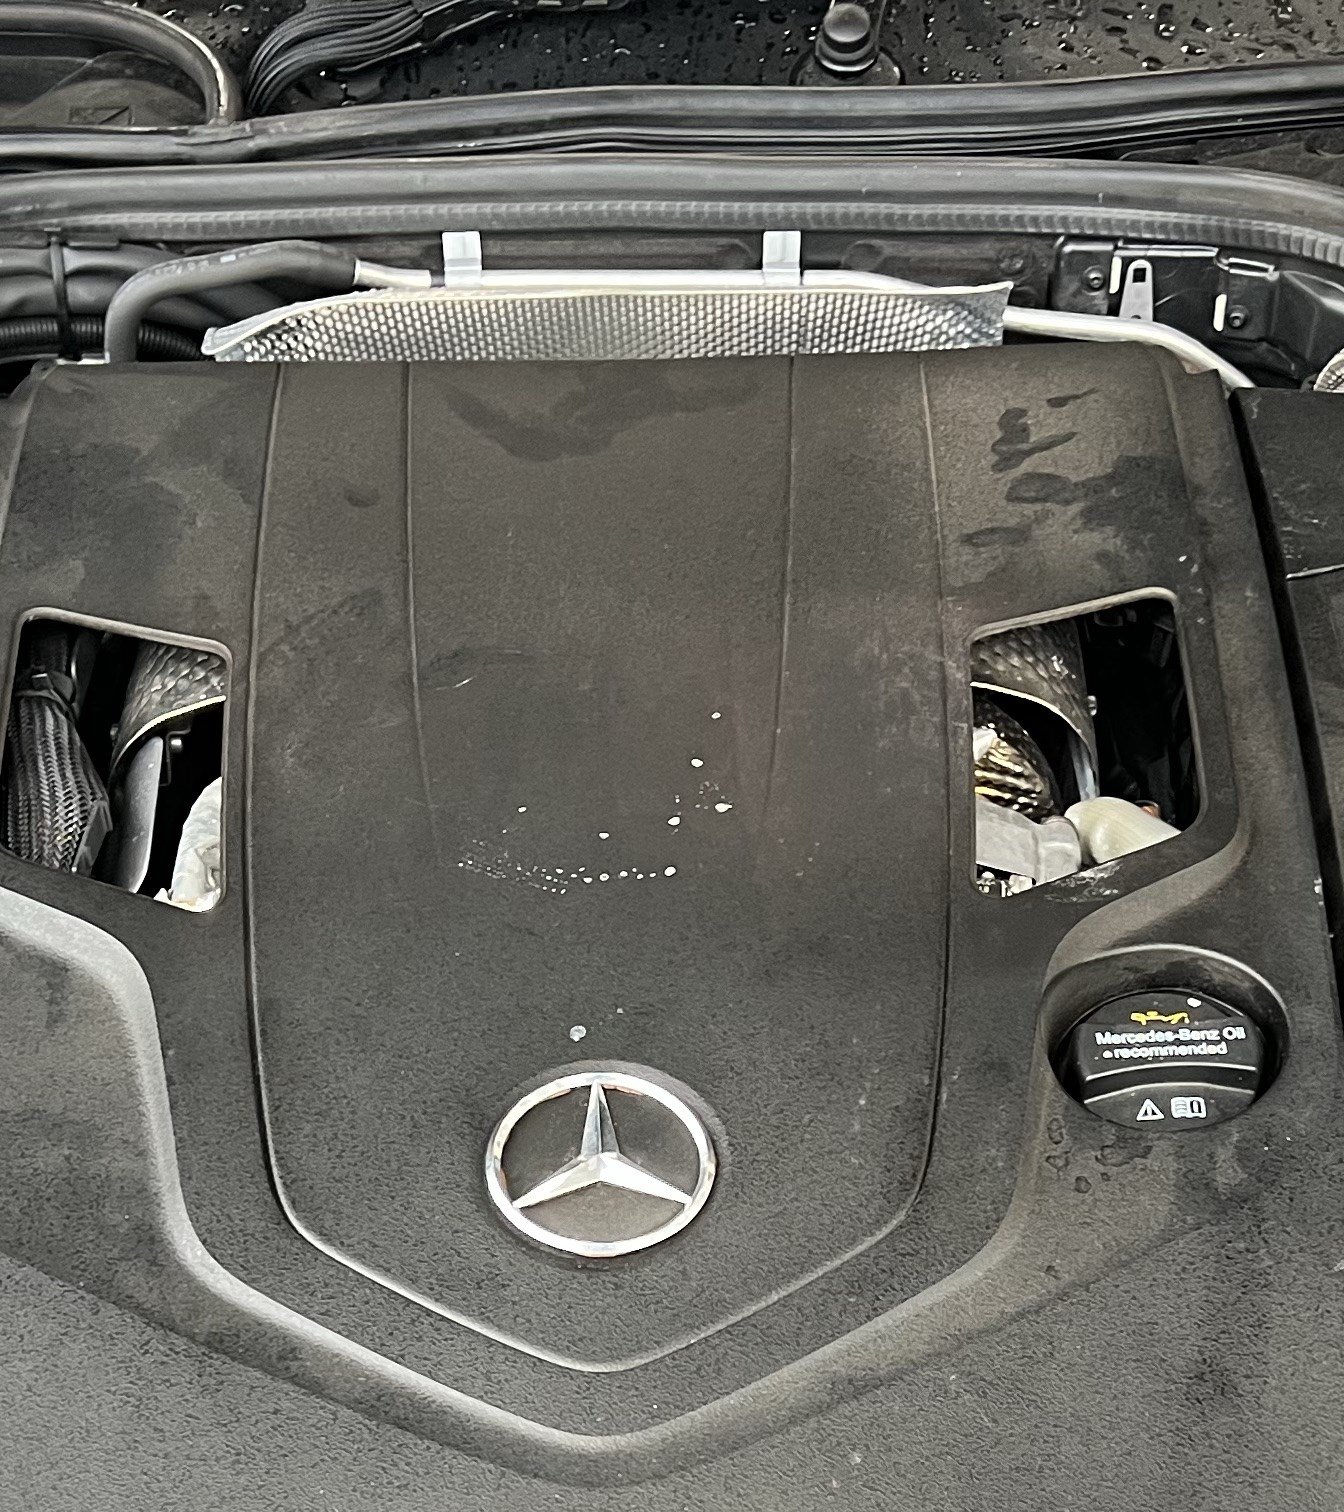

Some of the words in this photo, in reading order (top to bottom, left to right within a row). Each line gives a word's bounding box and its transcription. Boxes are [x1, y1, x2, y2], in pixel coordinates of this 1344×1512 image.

[1095, 1027, 1220, 1045] Mercedes-Benz
[1222, 1026, 1246, 1041] Oil
[1114, 1042, 1228, 1059] recommended
